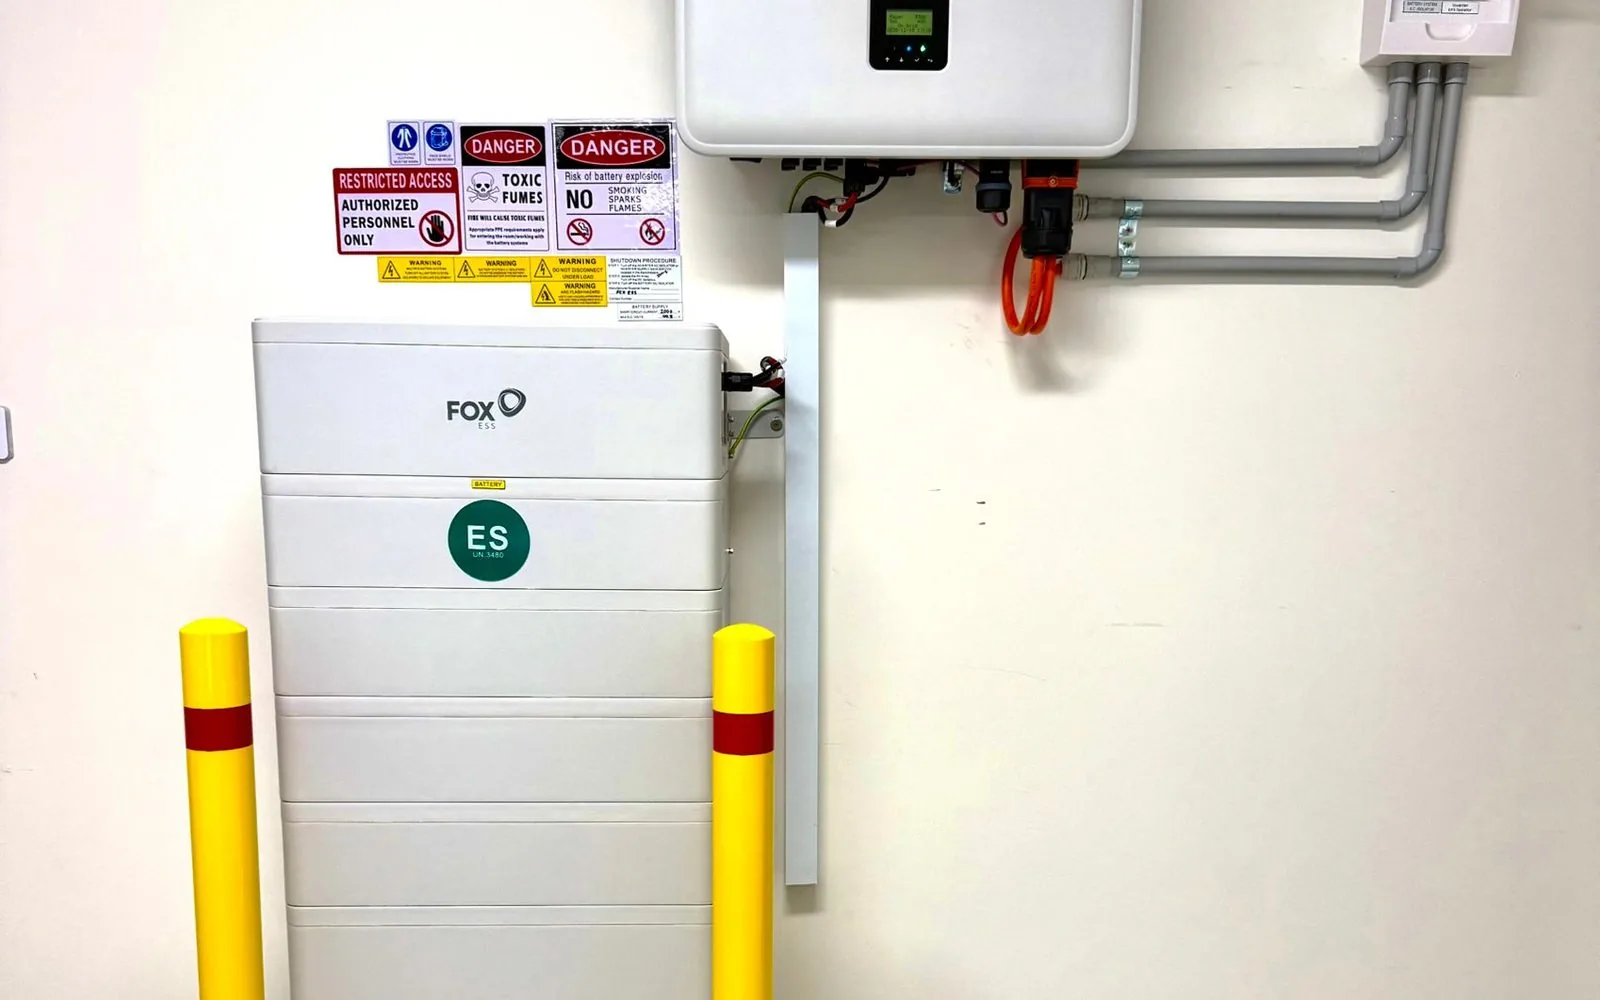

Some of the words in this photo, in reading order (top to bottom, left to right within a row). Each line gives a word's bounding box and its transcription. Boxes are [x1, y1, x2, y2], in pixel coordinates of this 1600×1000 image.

[472, 139, 536, 154] DANGER
[571, 139, 657, 156] DANGER
[339, 172, 406, 189] RESTRICTED
[409, 172, 452, 189] ACCESS
[502, 173, 542, 187] TOXIC
[565, 171, 581, 181] Risk
[584, 171, 592, 181] of
[594, 171, 622, 183] battery
[625, 171, 663, 183] explosion
[608, 186, 647, 195] SMOKING
[502, 191, 543, 204] FUMES
[566, 189, 593, 209] NO
[608, 195, 642, 203] SPARKS
[342, 199, 419, 211] AUTHORIZED
[609, 204, 642, 212] FLAMES
[342, 216, 415, 228] PERSONNEL
[344, 234, 374, 246] ONLY
[447, 401, 495, 421] FOX
[478, 422, 496, 430] ESS
[467, 525, 508, 551] ES
